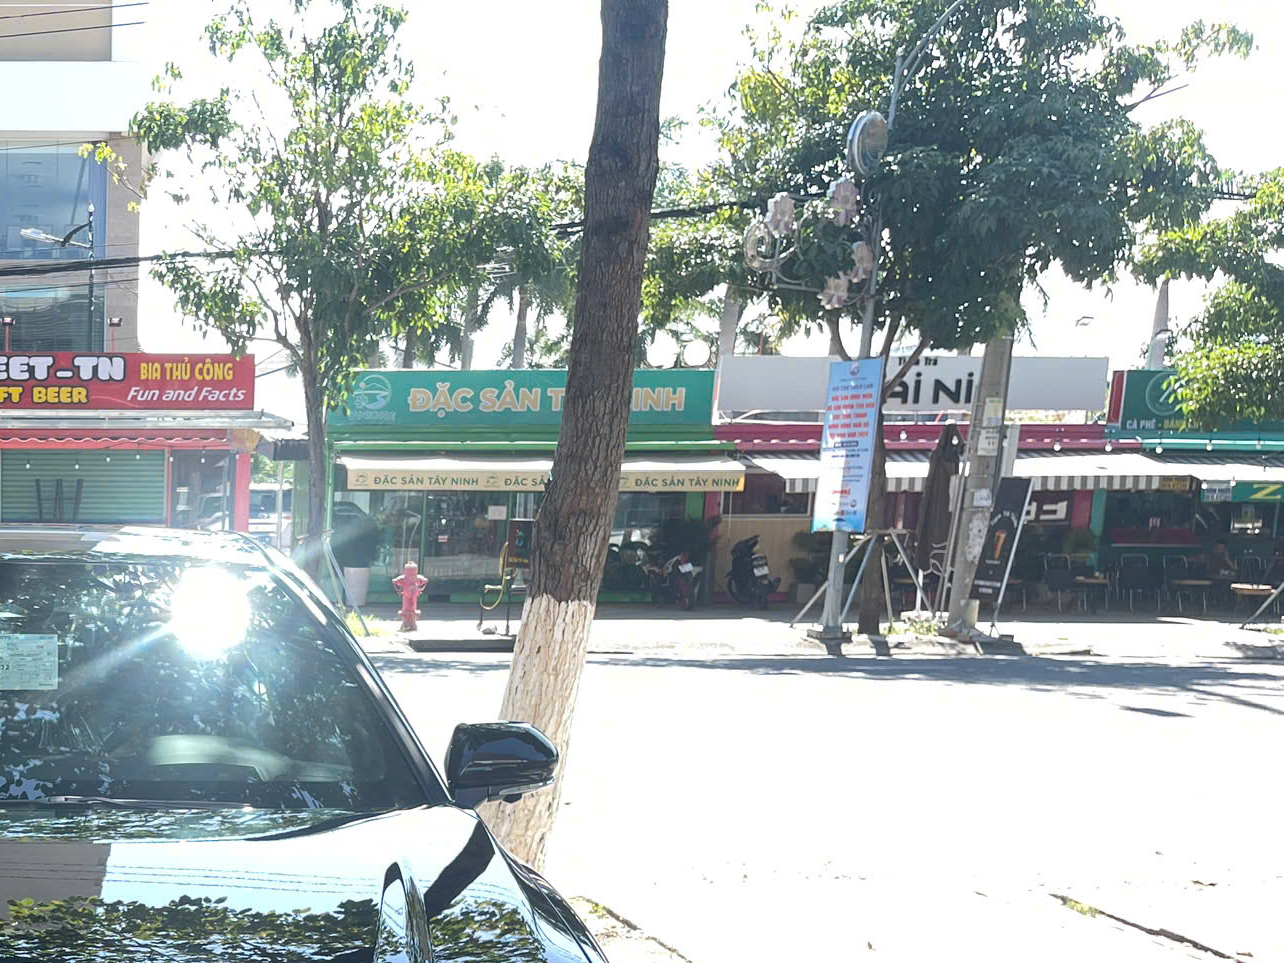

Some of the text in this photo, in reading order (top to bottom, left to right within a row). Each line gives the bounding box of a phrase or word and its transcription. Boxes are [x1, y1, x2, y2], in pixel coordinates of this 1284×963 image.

[140, 357, 233, 380] BIA THỦ CÔNG
[32, 387, 88, 403] BEER
[127, 386, 246, 401] Fun and Facts
[408, 382, 474, 417] ĐẶC
[479, 380, 541, 412] SẢN
[630, 387, 686, 412] INH
[401, 474, 423, 486] SẢN
[427, 475, 447, 486] TÂY
[451, 478, 479, 486] NINH
[531, 475, 548, 487] SẢ
[662, 476, 684, 487] SẢN
[689, 477, 708, 487] TÂY
[711, 479, 740, 487] NINH
